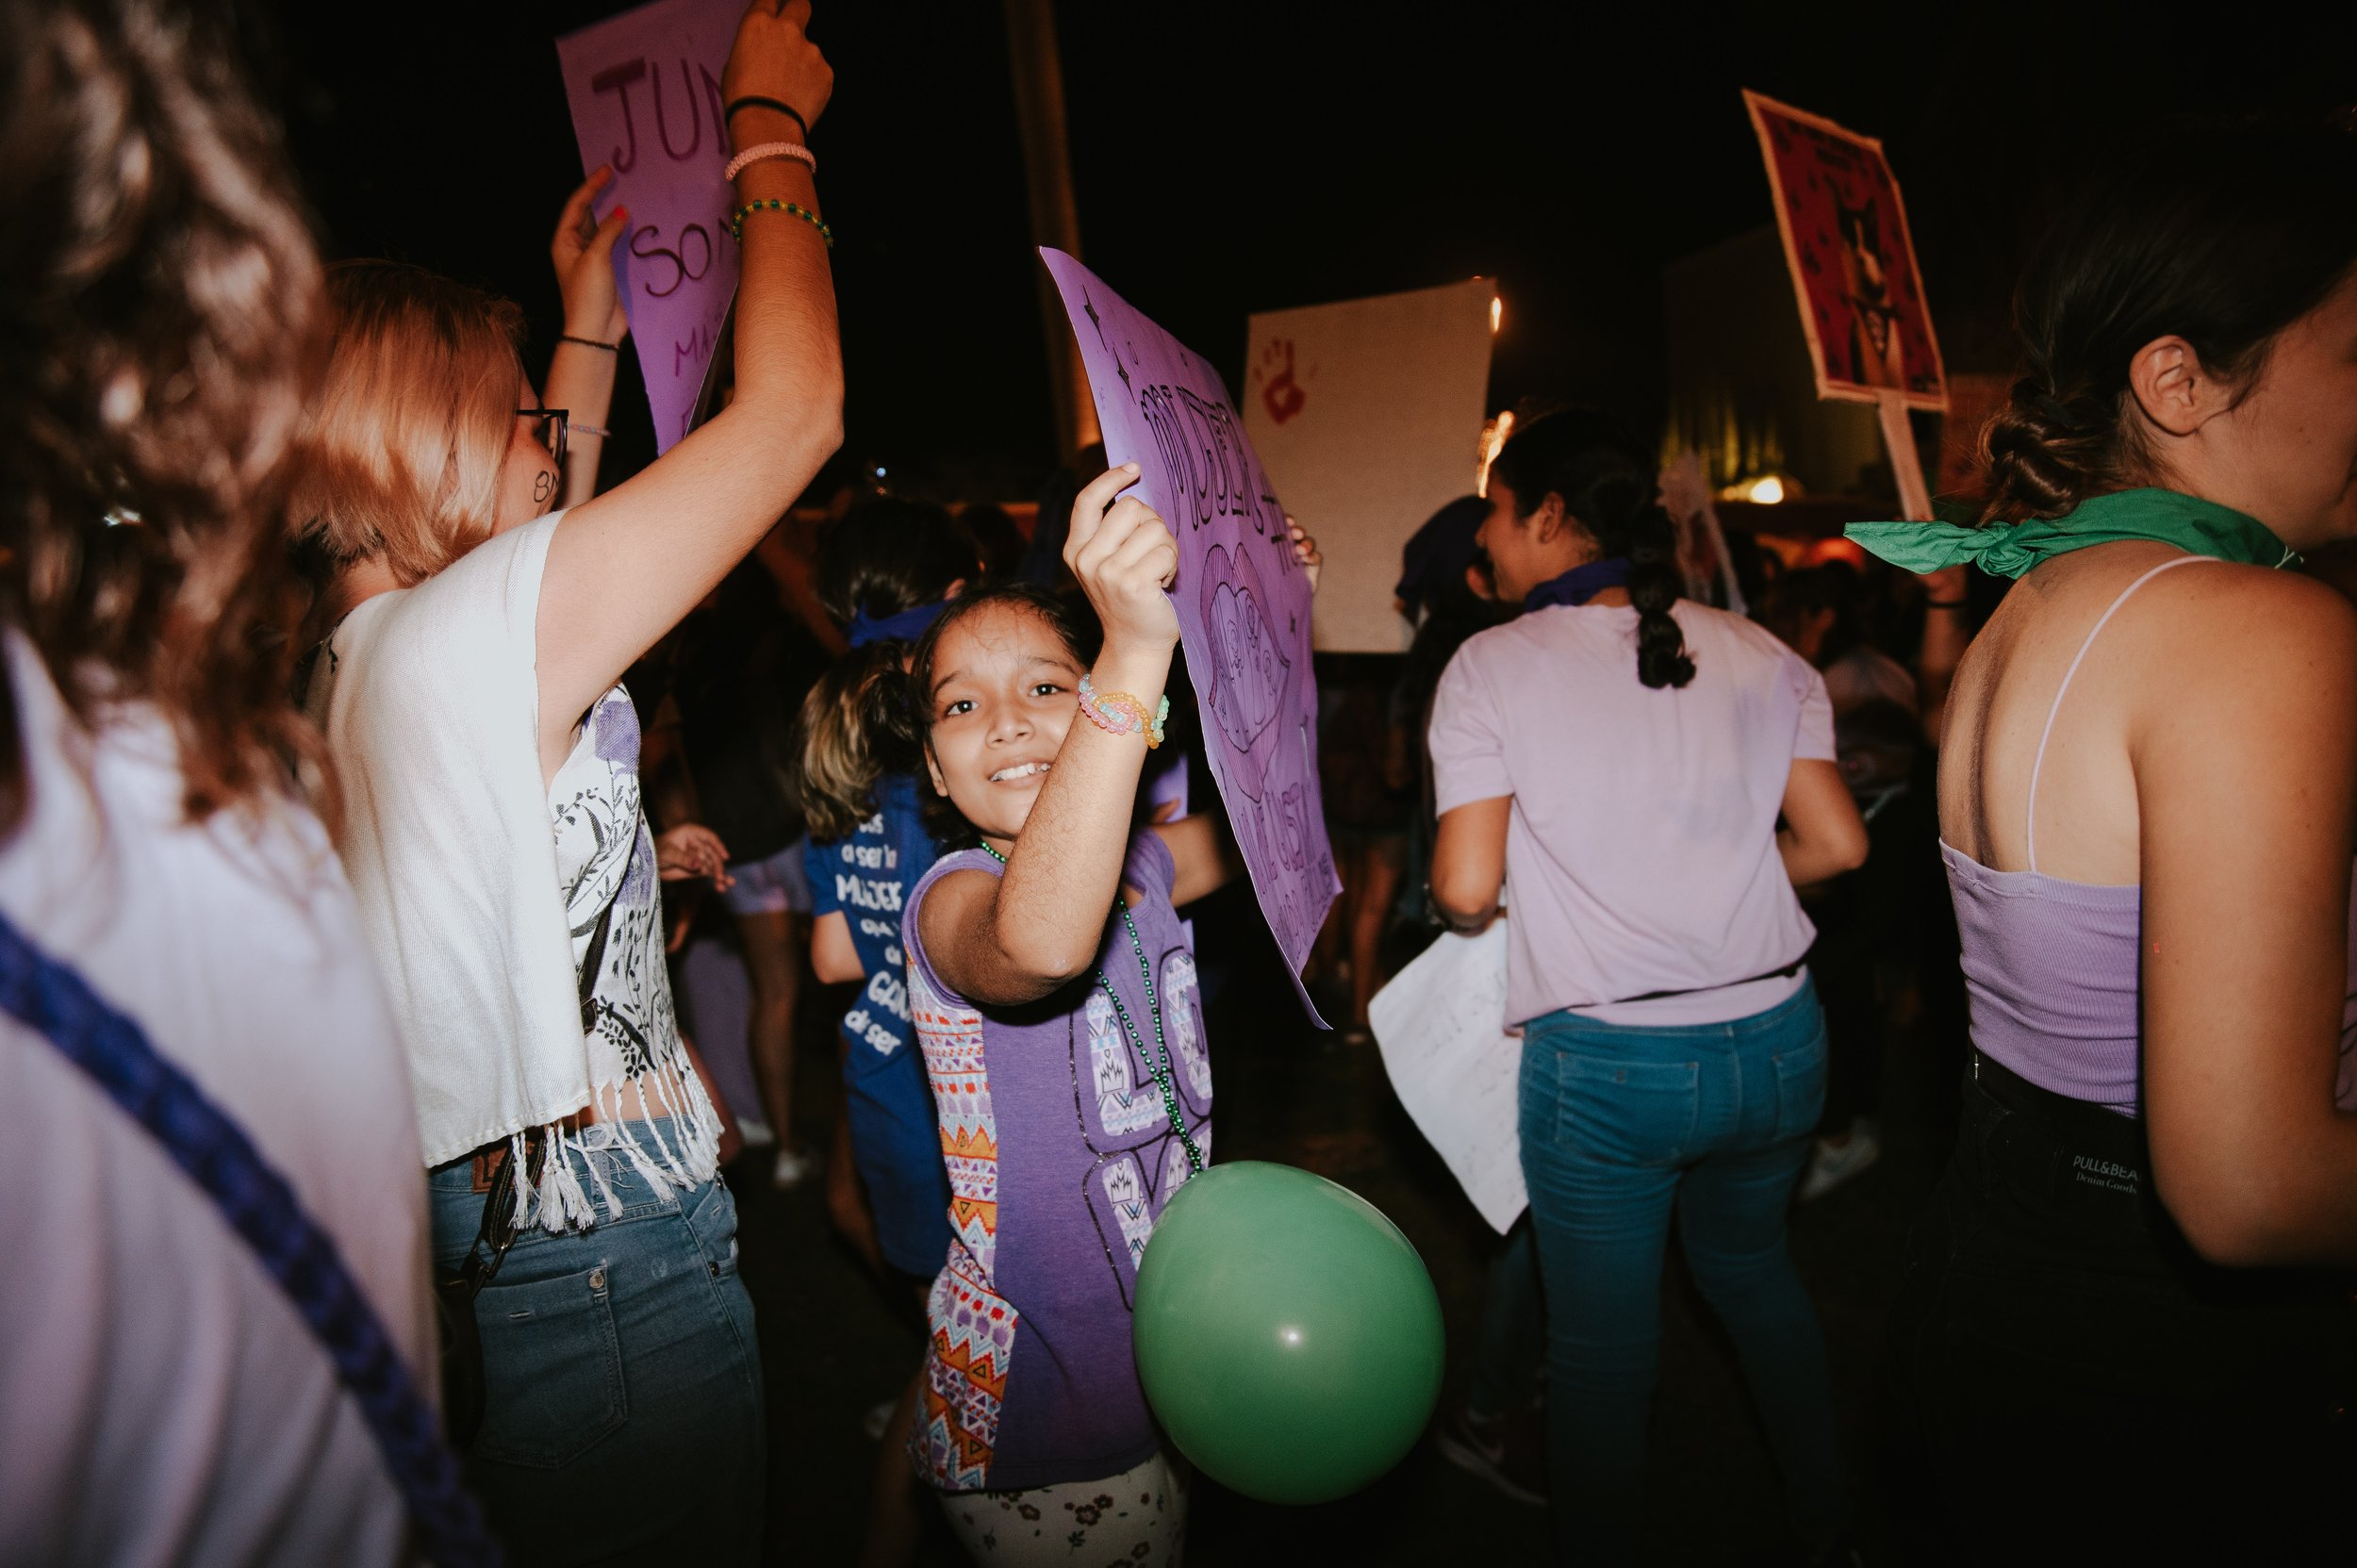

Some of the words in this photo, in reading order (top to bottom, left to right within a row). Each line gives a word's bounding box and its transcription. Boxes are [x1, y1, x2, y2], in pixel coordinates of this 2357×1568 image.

[1141, 384, 1264, 538] MUJER
[2073, 1155, 2141, 1182] PULL&BEA
[2076, 1172, 2105, 1187] Denim
[2106, 1178, 2138, 1195] Goods
